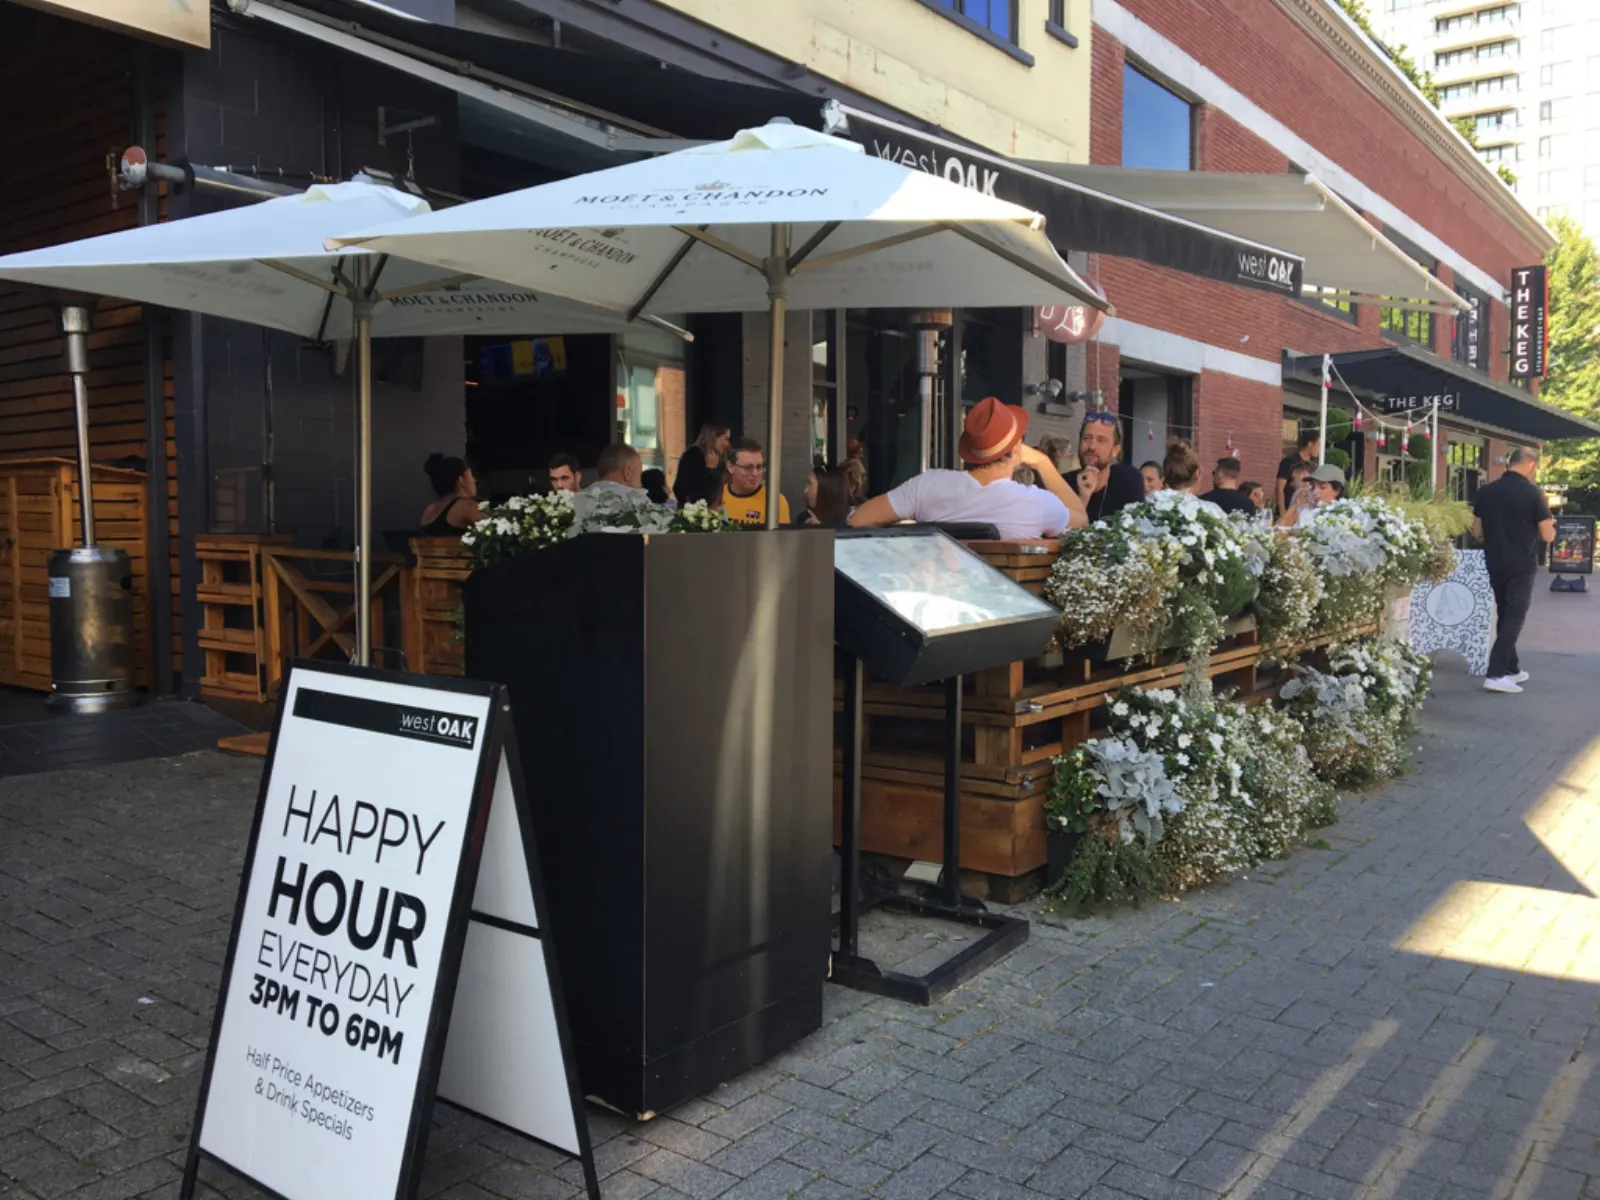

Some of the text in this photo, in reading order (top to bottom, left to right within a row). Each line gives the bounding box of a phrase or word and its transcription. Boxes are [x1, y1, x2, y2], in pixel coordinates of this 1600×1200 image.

[683, 188, 829, 202] CHANDON
[943, 157, 1000, 199] OAK
[449, 292, 538, 305] CHANDON
[1238, 252, 1294, 285] west OAK
[1515, 271, 1530, 373] THE KEG
[1388, 396, 1416, 408] THE
[401, 713, 474, 739] west OAK
[282, 784, 446, 875] HAPPY
[267, 855, 427, 969] HOUR
[257, 929, 415, 1018] EVERYDAY
[249, 973, 404, 1065] 3PM TO 6PM
[246, 1046, 375, 1121] Half Price Appetizers
[254, 1077, 353, 1140] & Drink Specials
